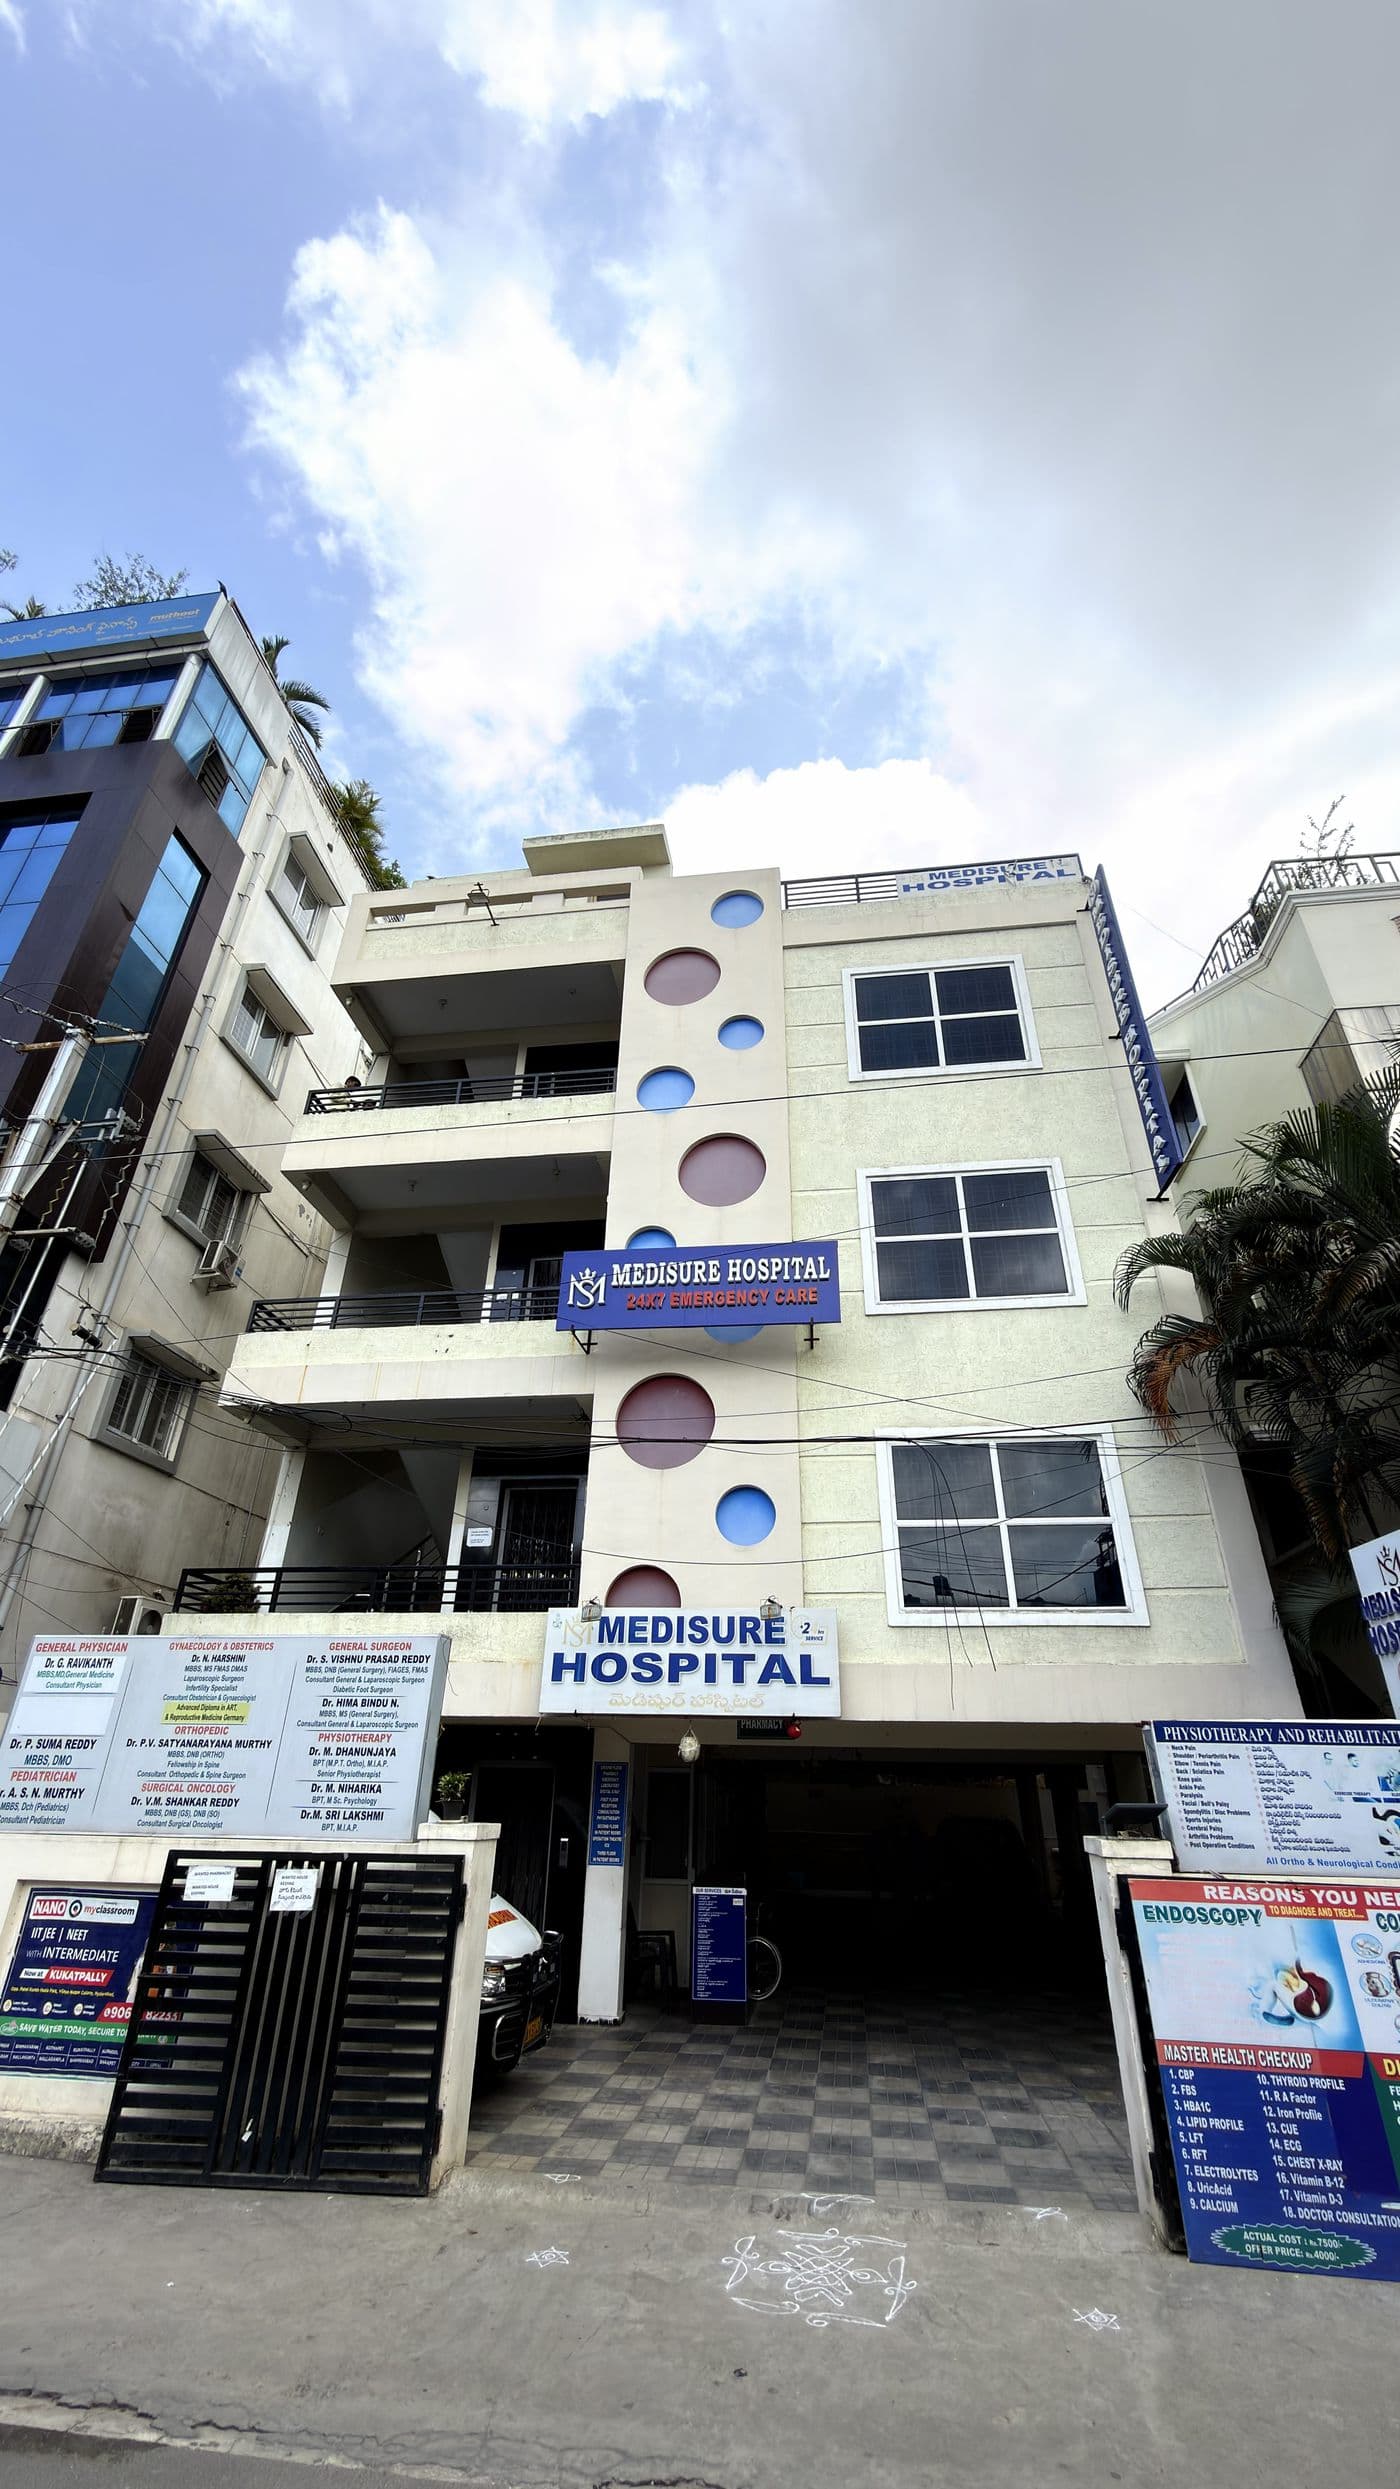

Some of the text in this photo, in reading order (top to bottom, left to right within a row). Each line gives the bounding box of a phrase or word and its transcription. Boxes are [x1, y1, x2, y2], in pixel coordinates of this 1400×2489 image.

[928, 861, 1048, 881] MEDISURE
[902, 868, 1077, 893] HOSPITAL
[611, 1256, 831, 1287] MEDISURE HOSPITAL
[626, 1287, 818, 1310] 24X7 EMERGENCY CARE
[597, 1615, 786, 1645] MEDISURE
[35, 1641, 128, 1652] GENERAL PHYSICIAN
[169, 1641, 273, 1651] GYNAECOLOGY & OBSTETRICS
[328, 1641, 411, 1651] GENERAL SURGEON
[44, 1657, 113, 1668] Dr. G. RAVIKANTH
[190, 1653, 245, 1663] Dr. N. HARSHINI
[306, 1654, 430, 1664] Dr. S. VISHNU PRASAD REDDY
[550, 1651, 832, 1686] HOSPITAL
[183, 1674, 244, 1683] Laparoscopic Surgeon
[332, 1685, 393, 1694] Diabetic Foot Surgeon
[321, 1697, 399, 1708] Dr. HIMA BINDU N.
[174, 1725, 228, 1735] ORTHOPEDIC
[740, 1719, 784, 1729] PHARMACY
[318, 1731, 391, 1743] PHYSIOTHERAPY
[1163, 1726, 1273, 1742] PHYSIOTHERAPY
[1278, 1728, 1304, 1743] AND
[9, 1738, 97, 1749] Dr. P. SUMA REDDY
[125, 1738, 272, 1749] Dr. P.V. SATYANARAYANA MURTHY
[308, 1746, 396, 1757] Dr. M. DHANUNJAYA
[23, 1753, 72, 1766] MBBS, DMO
[10, 1770, 76, 1782] PEDIATRICIAN
[316, 1768, 381, 1779] Senior Physiotherapist
[141, 1782, 235, 1794] SURGICAL ONCOLOGY
[310, 1782, 382, 1794] Dr. M. NIHARIKA
[130, 1795, 239, 1807] Dr. V.M. SHANKAR REDDY
[300, 1809, 384, 1821] Dr.M. SRI LAKSHMI
[136, 1818, 223, 1830] Consultant Surgical Oncologist
[1265, 1856, 1278, 1864] All
[1279, 1856, 1305, 1865] Ortho
[1306, 1857, 1315, 1866] &
[1316, 1858, 1373, 1868] Neurological
[1204, 1885, 1304, 1904] REASONS
[1311, 1889, 1358, 1906] YOU
[33, 1900, 135, 1916] NANO myclassroom
[1268, 1904, 1279, 1915] TO
[1279, 1905, 1316, 1916] DIAGNOSE
[1317, 1906, 1333, 1917] AND
[1142, 1904, 1262, 1927] ENDOSCOPY
[66, 1929, 89, 1941] NEET
[26, 1946, 120, 1963] WITH INTERMEDIATE
[49, 1970, 108, 1983] KUKATPALLY
[19, 2022, 114, 2037] SAVE WATER TODAY, SECURE
[1163, 2044, 1313, 2070] MASTER HEALTH CHECKUP
[1168, 2067, 1194, 2080] 1. CBP
[1256, 2073, 1345, 2090] 10. THYROID PROFILE
[1170, 2083, 1197, 2096] 2. FBS
[1259, 2089, 1316, 2104] 11. R A Factor
[1173, 2098, 1211, 2112] 3. HBA1C
[1176, 2115, 1244, 2131] 4. LIPID PROFILE
[1272, 2154, 1342, 2171] 15. CHEST X-RAY
[1275, 2171, 1344, 2188] 16. Vitamin B-12
[1189, 2197, 1238, 2213] 9. CALCIUM
[1282, 2205, 1296, 2218] 18.
[1296, 2206, 1334, 2222] DOCTOR
[1243, 2230, 1277, 2242] ACTUAL
[1278, 2233, 1301, 2245] COST
[1244, 2243, 1273, 2254] OFFER
[1274, 2245, 1304, 2257] PRICE:
